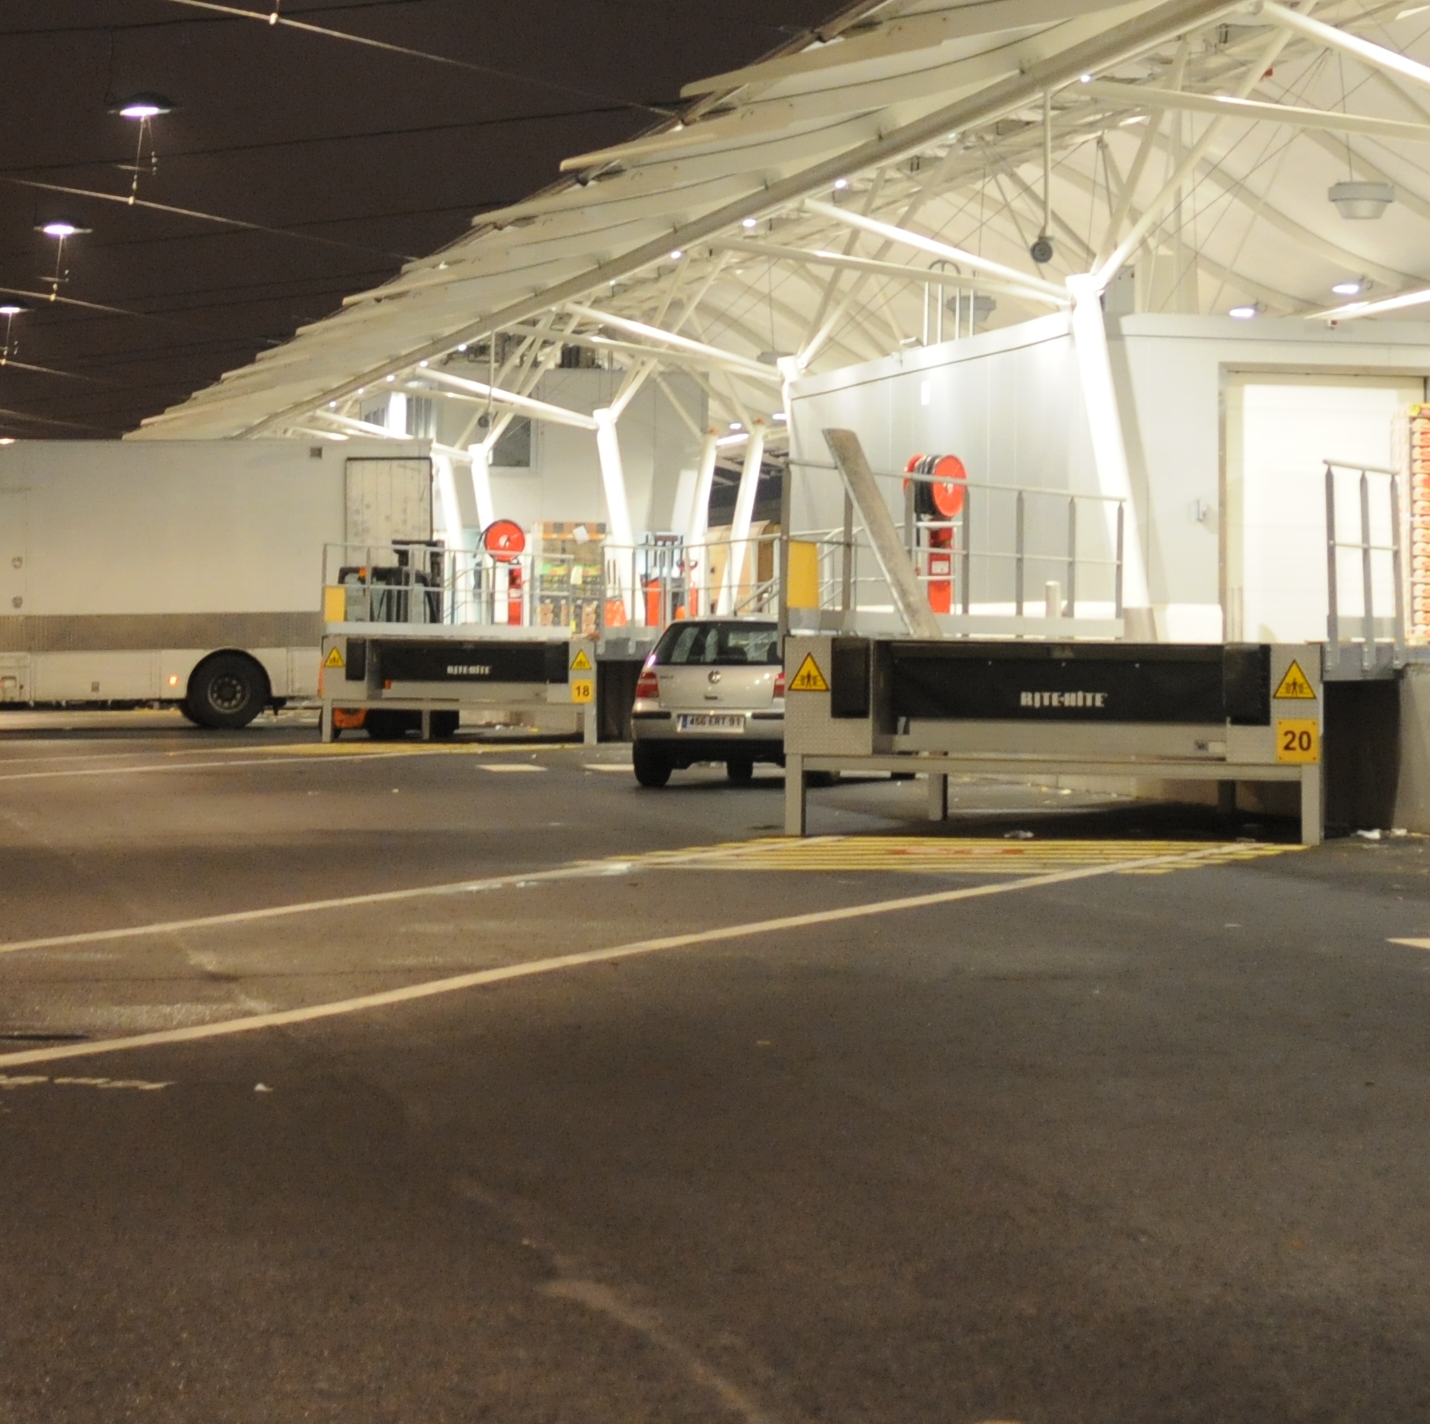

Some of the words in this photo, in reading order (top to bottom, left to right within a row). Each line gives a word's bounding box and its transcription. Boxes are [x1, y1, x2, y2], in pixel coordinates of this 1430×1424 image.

[575, 685, 590, 697] 18
[1020, 691, 1108, 708] RITE-HITE
[1283, 729, 1312, 752] 20
